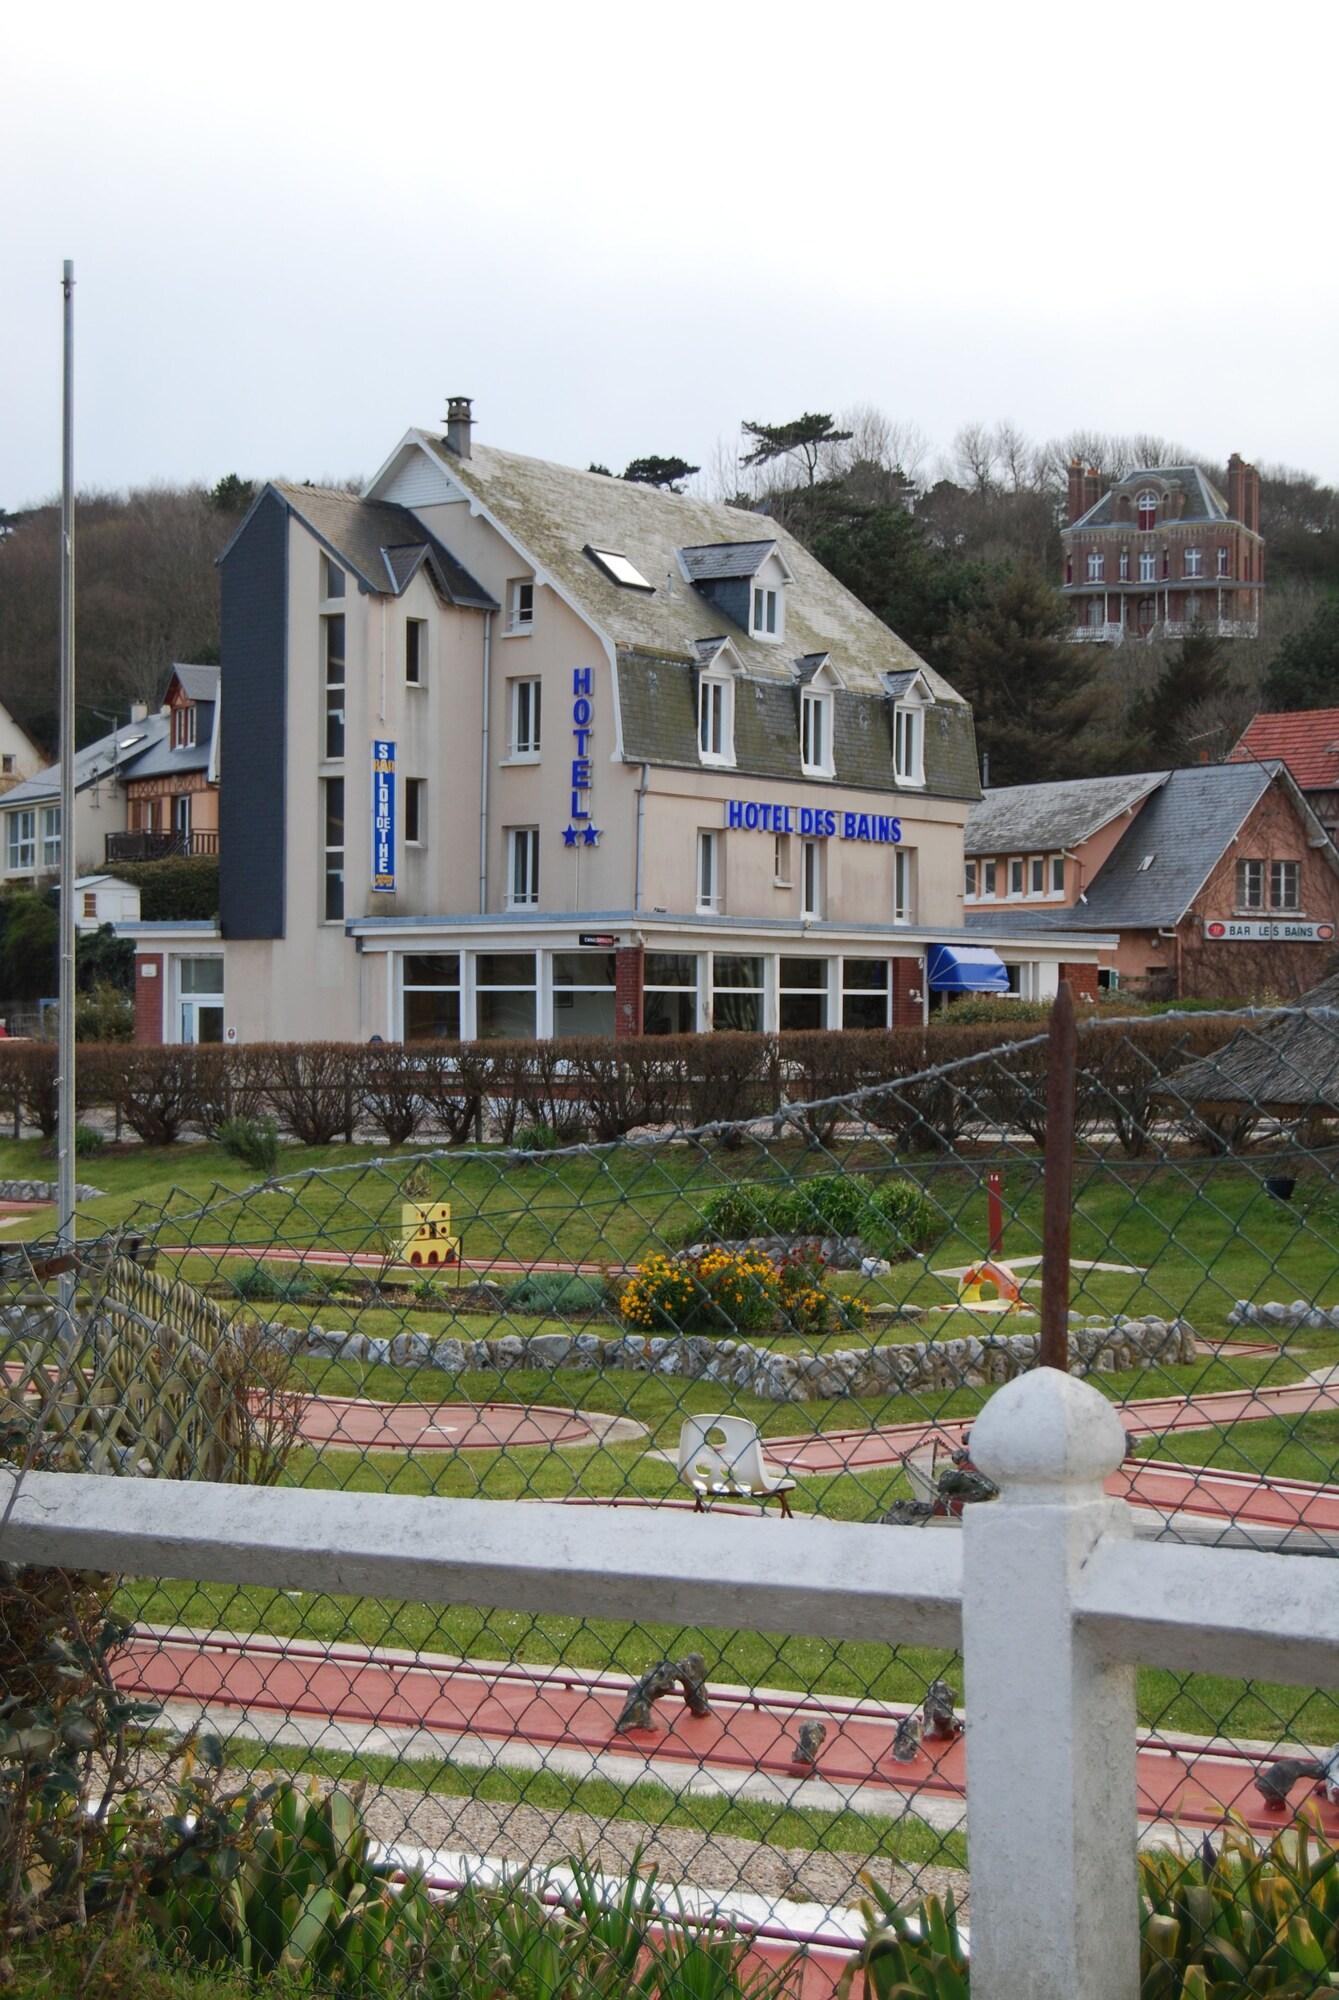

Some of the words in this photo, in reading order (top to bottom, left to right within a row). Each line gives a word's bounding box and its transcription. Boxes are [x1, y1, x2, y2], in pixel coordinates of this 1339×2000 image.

[571, 667, 593, 819] HOTEL
[376, 816, 391, 829] DE
[729, 799, 794, 833] HOTEL
[800, 807, 836, 837] DES
[844, 811, 902, 844] BAINS
[378, 829, 389, 873] THE
[1229, 926, 1251, 936] BAR
[1258, 926, 1280, 937] LES
[1284, 927, 1313, 937] BAINS
